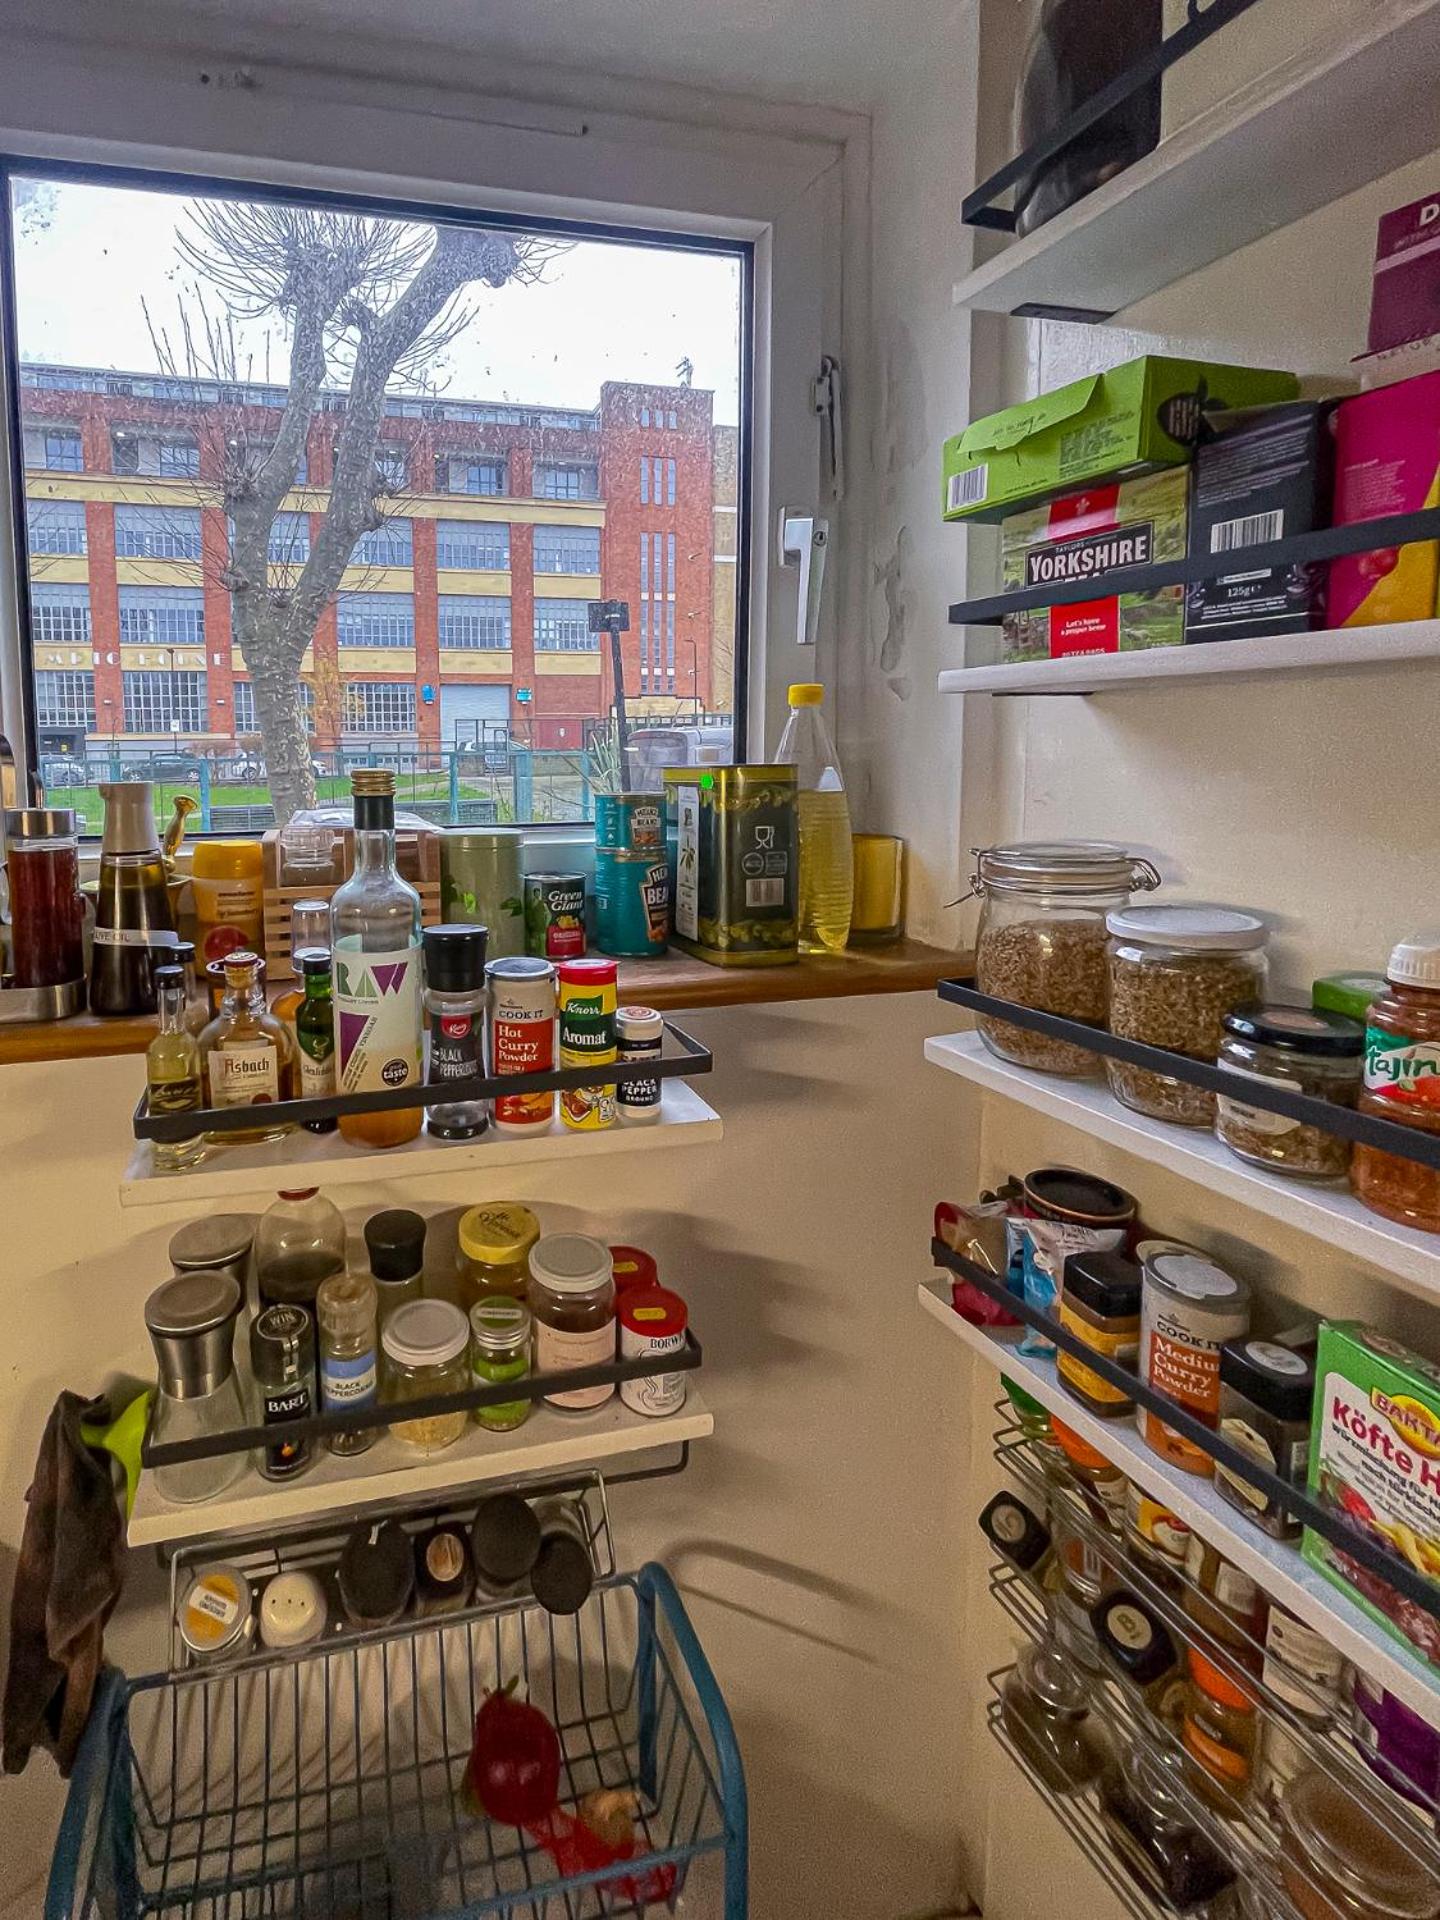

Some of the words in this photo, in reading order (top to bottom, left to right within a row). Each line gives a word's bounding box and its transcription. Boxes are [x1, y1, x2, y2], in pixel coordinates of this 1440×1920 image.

[1030, 535, 1147, 582] YORKSHIRE
[548, 890, 583, 901] Green
[551, 899, 583, 912] Giant
[336, 961, 409, 997] RAW
[499, 1010, 532, 1020] COOK
[534, 1009, 545, 1018] IT
[567, 1001, 601, 1015] Knorr
[498, 1024, 522, 1038] Hot
[562, 1025, 608, 1046] Aromat
[498, 1038, 539, 1053] Curry
[498, 1049, 538, 1062] Powder
[224, 1057, 270, 1075] Asbach
[622, 1085, 657, 1095] PEPPER
[1156, 1320, 1203, 1348] COOK
[1153, 1352, 1212, 1388] Curry
[1153, 1364, 1211, 1398] Powder
[268, 1391, 306, 1413] BART
[1333, 1395, 1414, 1474] Köfte
